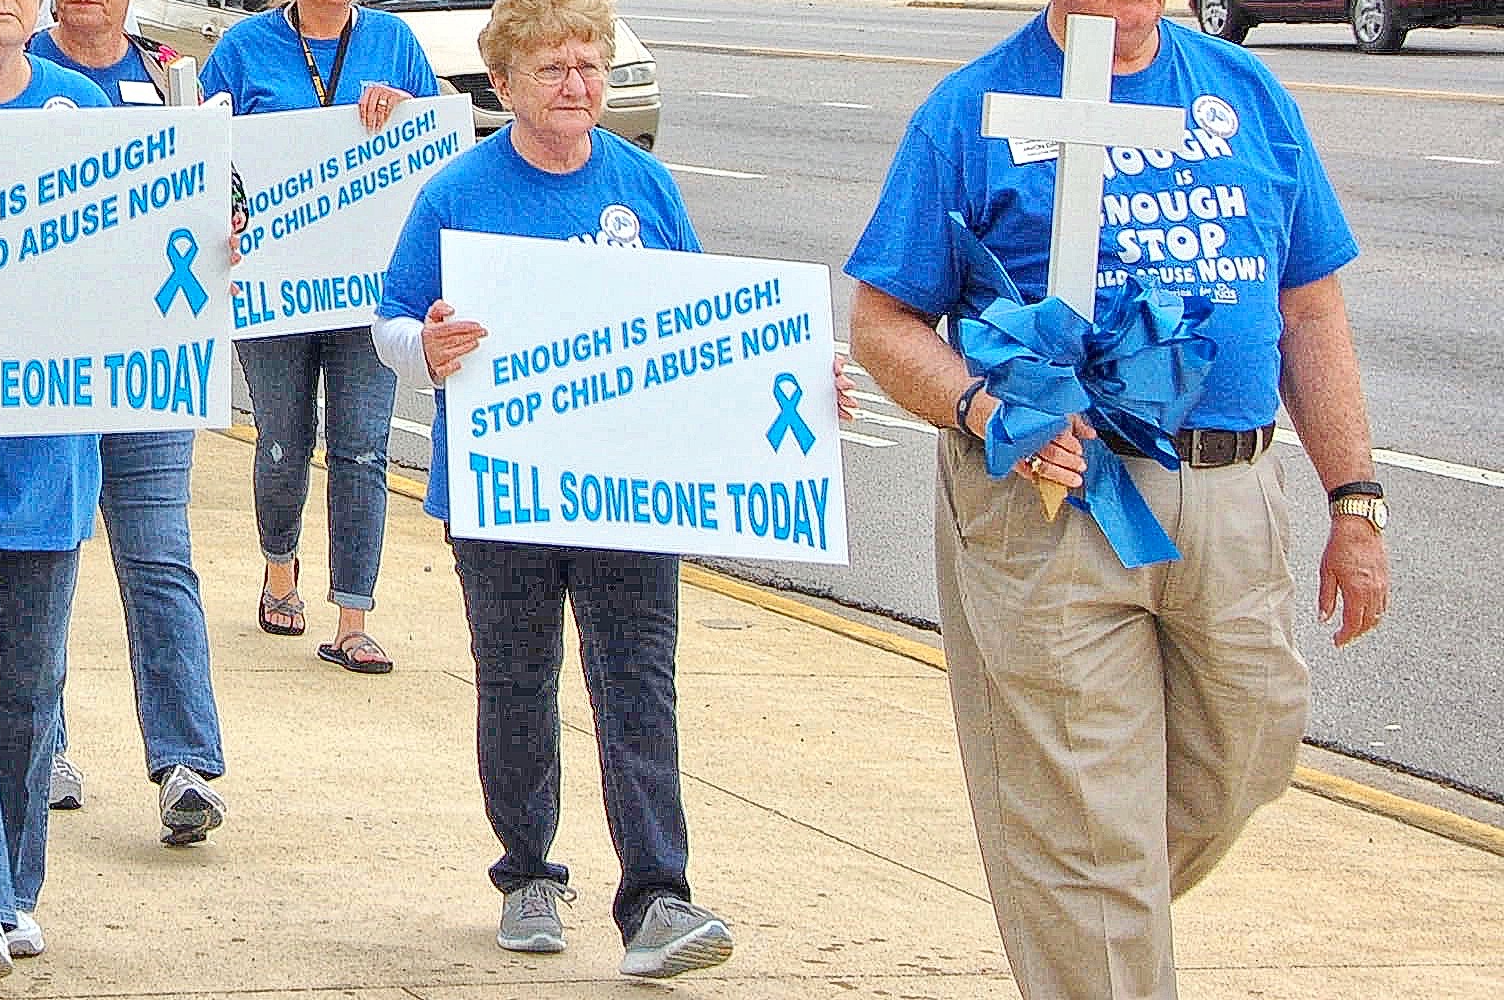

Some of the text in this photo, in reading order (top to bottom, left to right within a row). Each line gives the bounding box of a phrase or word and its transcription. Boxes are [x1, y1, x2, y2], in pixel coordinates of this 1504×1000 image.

[0, 184, 28, 221] IS
[37, 126, 176, 206] ENOUGH!
[320, 157, 339, 183] IS
[346, 109, 436, 170] ENOUGH!
[1174, 168, 1194, 185] IS
[19, 196, 118, 262] ABUSE
[128, 162, 206, 219] NOW!
[240, 131, 459, 255] OP CHILD ABUSE NOW!
[1096, 186, 1246, 226] NOUGH
[1097, 270, 1128, 288] ILD
[1197, 256, 1265, 283] NOW!
[1116, 222, 1225, 263] STOP
[232, 272, 387, 329] ELL SOMEON
[493, 278, 781, 387] ENOUGH IS ENOUGH!
[104, 338, 215, 418] TODAY
[471, 314, 811, 438] STOP CHILD ABUSE NOW!
[469, 452, 829, 550] TELL SOMEONE TODAY
